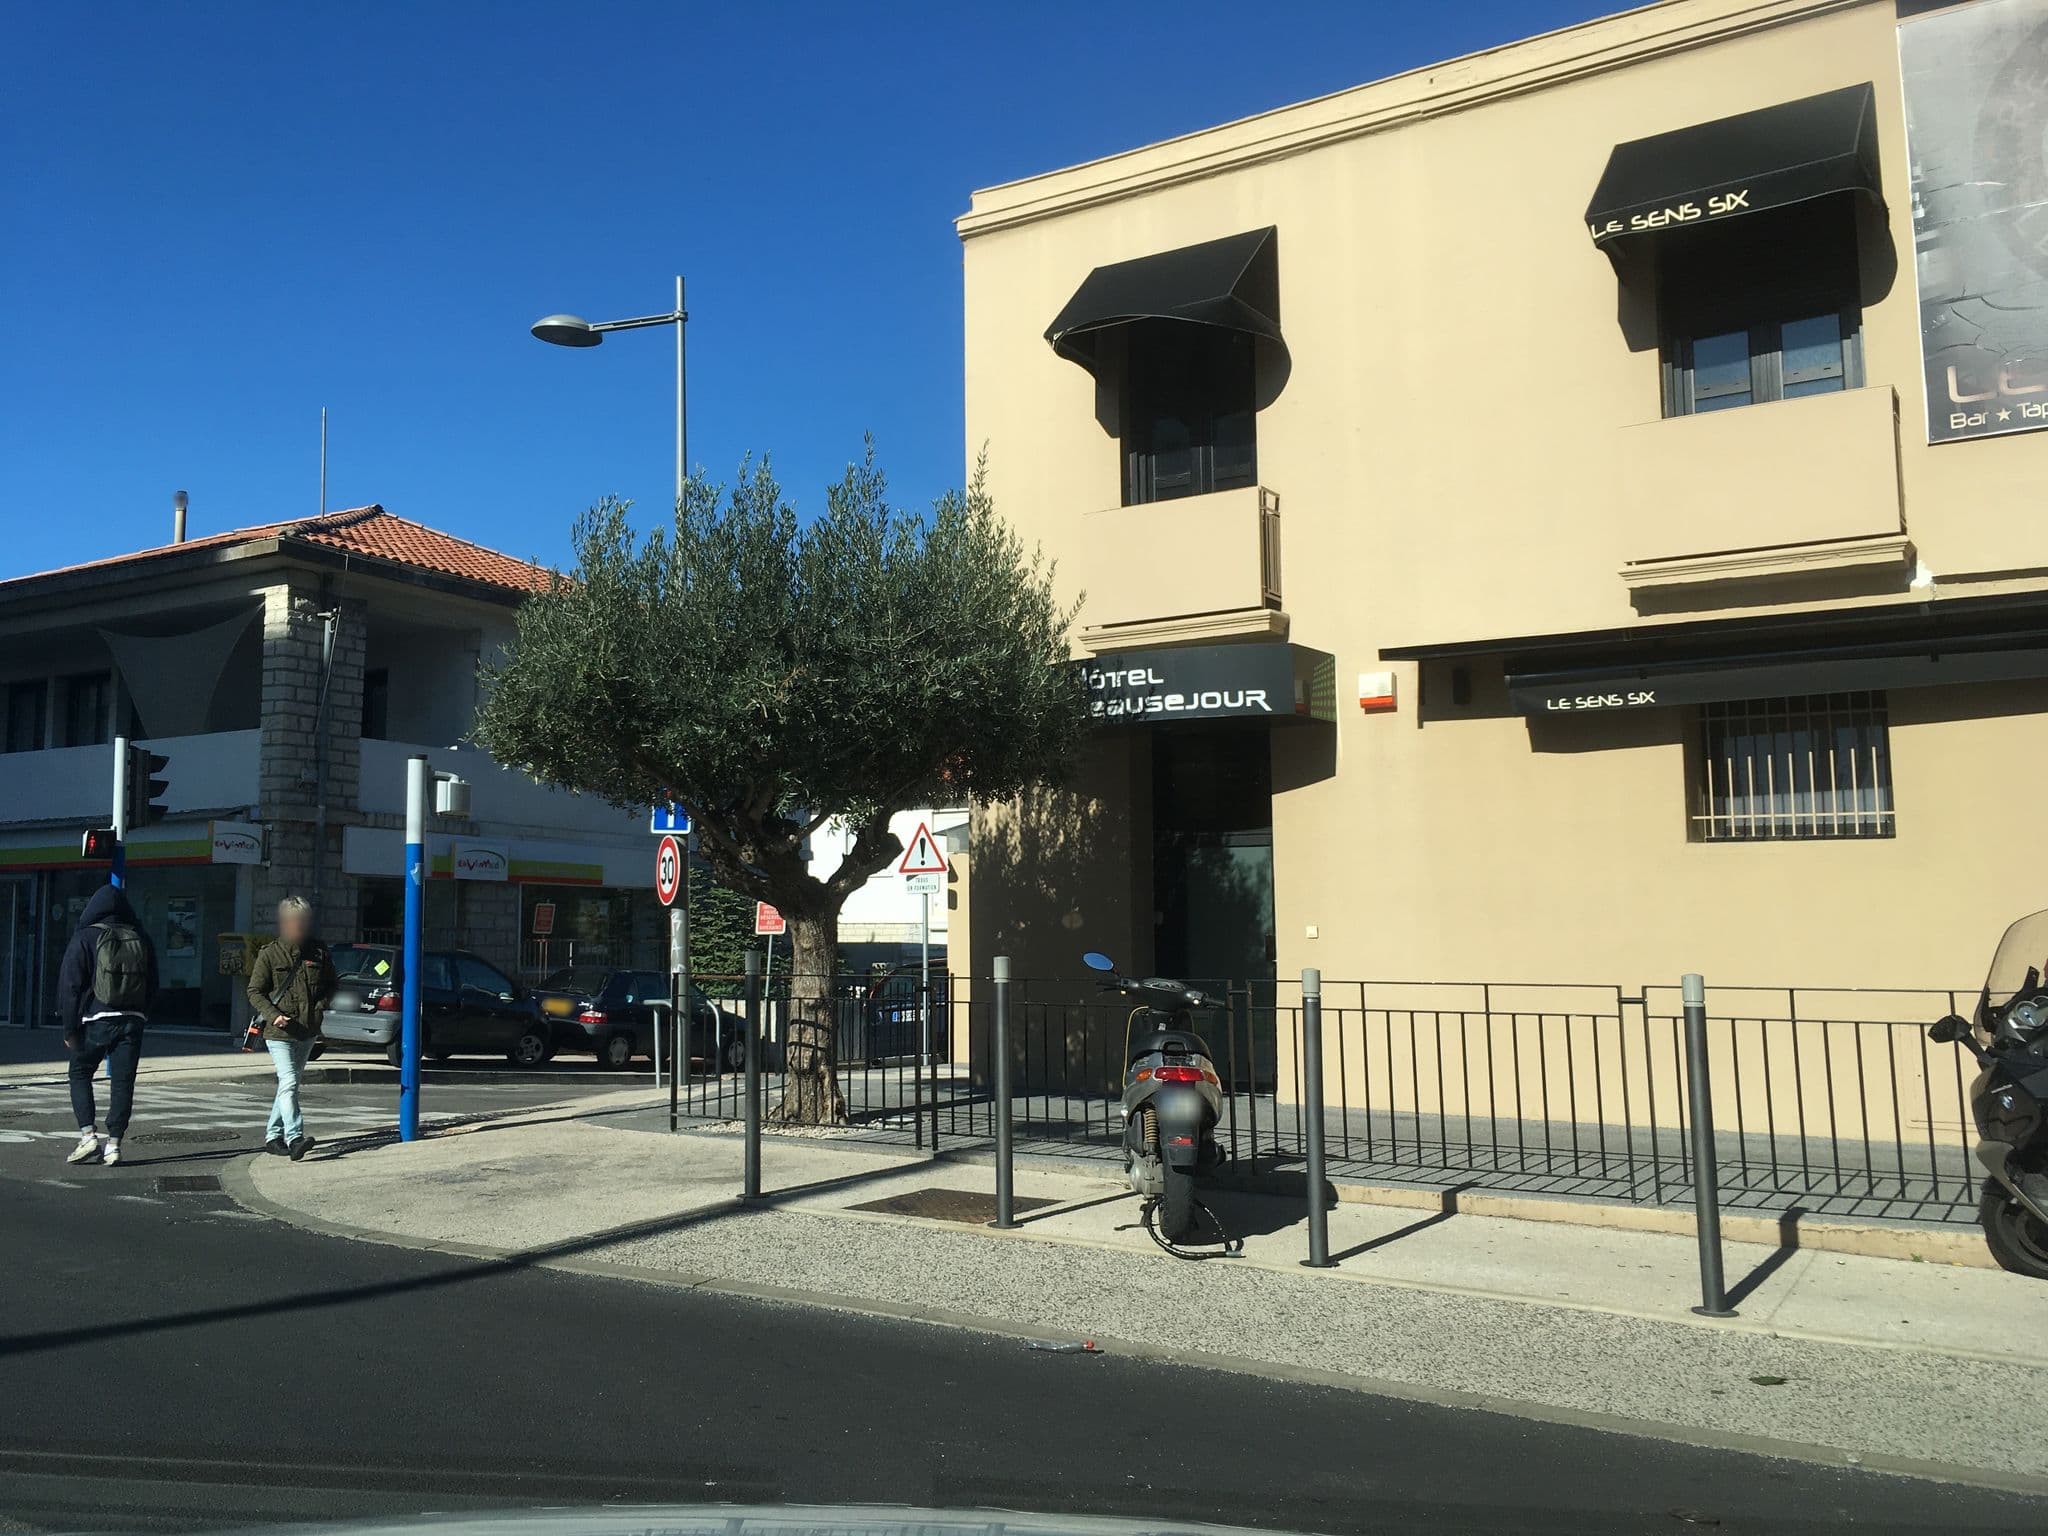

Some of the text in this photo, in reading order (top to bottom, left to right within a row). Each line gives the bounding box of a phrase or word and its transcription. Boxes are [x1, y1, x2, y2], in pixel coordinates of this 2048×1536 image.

[1591, 189, 1749, 239] LE SENS SIX
[1950, 411, 1988, 430] Bar
[1547, 690, 1656, 710] LE SENS SIX
[661, 855, 675, 885] 30
